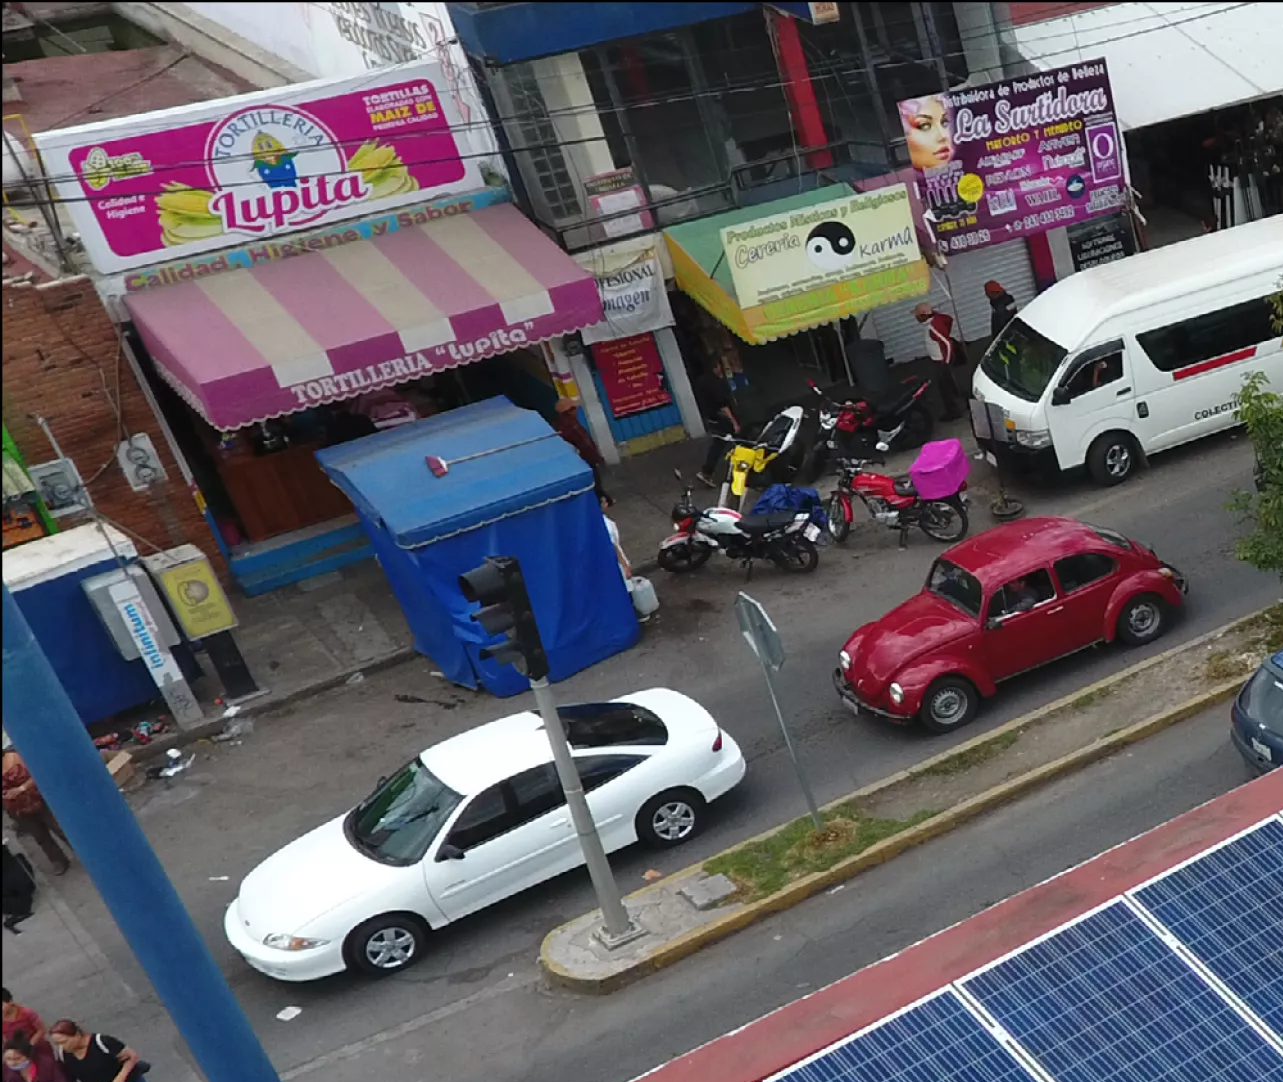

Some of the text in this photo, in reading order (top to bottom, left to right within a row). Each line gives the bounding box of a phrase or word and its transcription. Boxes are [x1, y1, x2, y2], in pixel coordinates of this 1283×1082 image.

[362, 84, 430, 107] TORTILLAS
[369, 100, 437, 125] MAIZ DE
[954, 108, 992, 144] La
[995, 86, 1107, 134] Surtidora
[214, 110, 325, 158] TORTILLERIA
[98, 195, 137, 211] Calidad
[106, 205, 146, 220] Higiene
[212, 174, 368, 233] Lupita
[396, 196, 474, 229] Sabor
[290, 353, 433, 403] TORTILLERIA
[124, 603, 165, 669] infinitum
